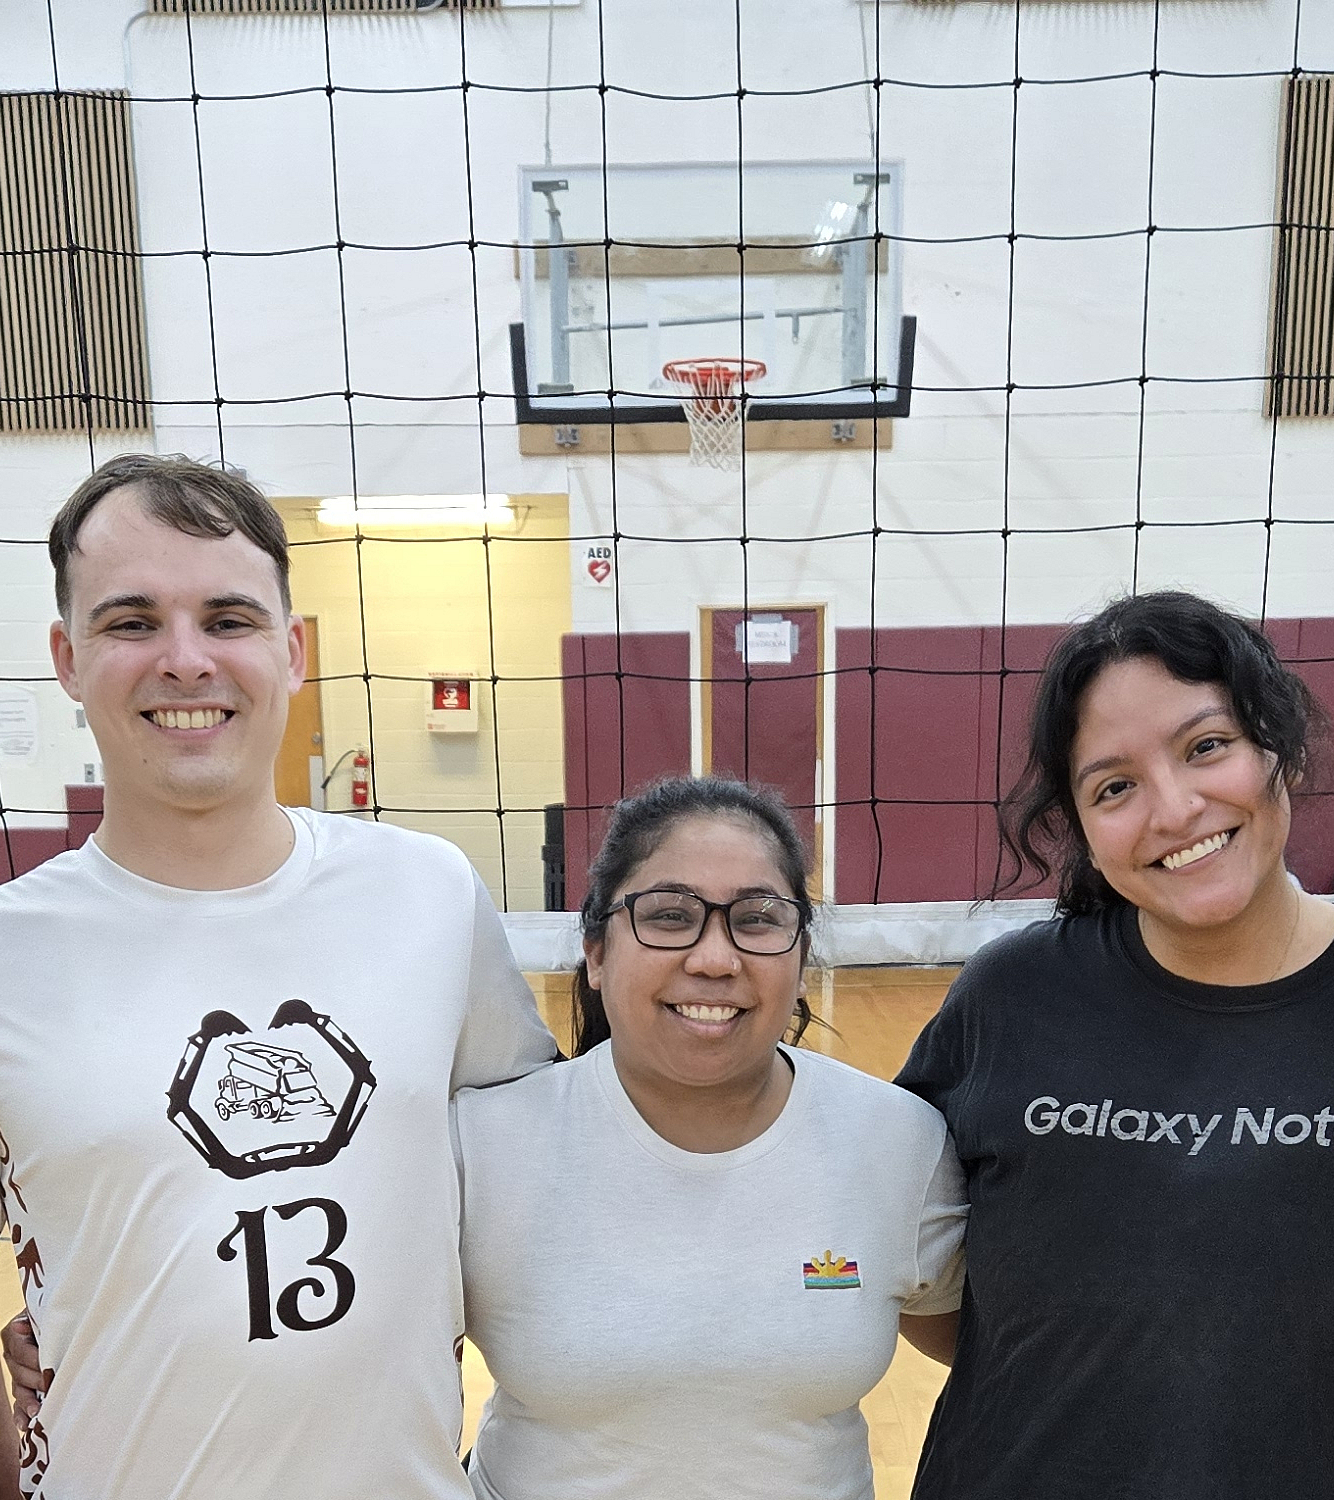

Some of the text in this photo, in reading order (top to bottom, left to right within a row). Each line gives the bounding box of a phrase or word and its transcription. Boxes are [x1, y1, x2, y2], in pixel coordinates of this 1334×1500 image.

[588, 546, 611, 559] AED
[1023, 1096, 1223, 1156] Galaxy
[216, 1197, 356, 1343] 13
